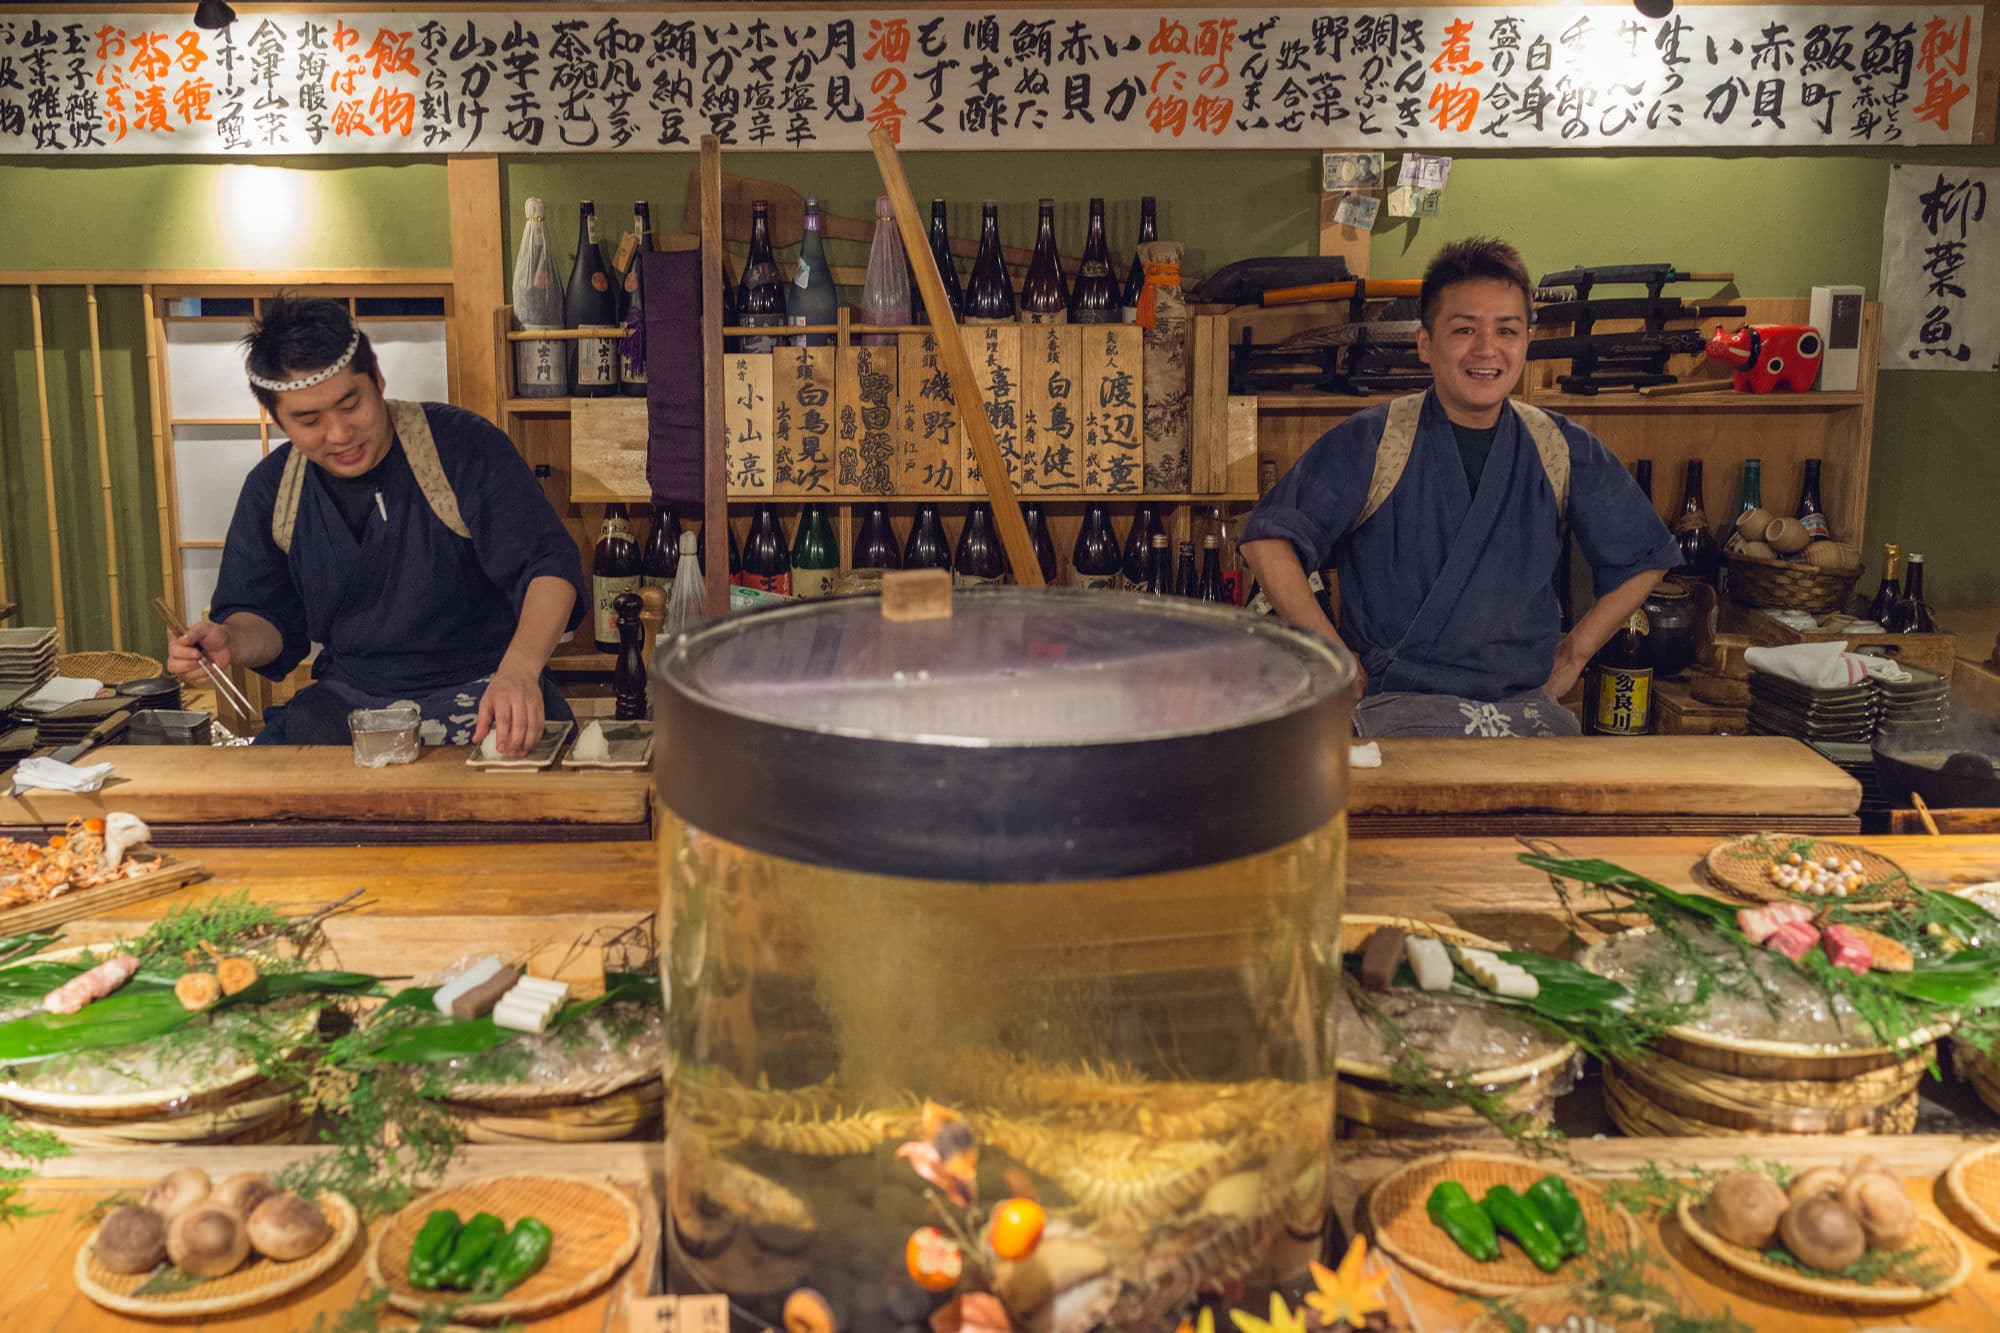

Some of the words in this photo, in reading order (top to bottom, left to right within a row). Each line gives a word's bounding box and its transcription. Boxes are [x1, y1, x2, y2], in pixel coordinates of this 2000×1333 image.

[62, 23, 106, 147] 玉子雑炊
[94, 24, 131, 143] おにぎり
[129, 31, 176, 133] 茶漬
[173, 29, 214, 124] 各種
[331, 19, 375, 137] わっぱ飯
[365, 27, 420, 137] 飯物
[418, 20, 451, 147] おくら刻み
[450, 19, 498, 151] 山かけ
[501, 19, 545, 146] 山芋千切
[549, 19, 599, 146] 茶碗むし
[593, 17, 645, 149] 和風サラダ
[646, 19, 696, 145] 鮪納豆
[700, 22, 742, 145] いか納豆
[777, 24, 818, 149] いか塩辛
[818, 19, 865, 122] 月見
[862, 18, 911, 145] 酒の肴
[913, 16, 960, 134] もずく
[1004, 19, 1056, 129] 鮪ぬた
[1058, 20, 1099, 124] 赤貝
[1103, 34, 1147, 122] いか
[1145, 16, 1191, 137] ぬた物
[1192, 17, 1238, 136] 酢の物
[1235, 16, 1280, 131] ぜんまい
[1272, 38, 1311, 133] 炊合せ
[1307, 16, 1349, 126] 野菜
[1350, 14, 1399, 135] 鯛かぶと
[1394, 18, 1426, 138] きんき
[1428, 17, 1484, 132] 煮物
[1480, 16, 1525, 138] 盛り合せ
[1512, 34, 1555, 131] 白身
[1646, 14, 1694, 129] 生うに
[1703, 35, 1750, 125] いか
[1751, 20, 1795, 129] 赤貝
[1882, 82, 1909, 142] 中とろ
[1912, 15, 1971, 132] 刺身
[1909, 173, 1988, 362] 柳葉魚
[736, 383, 766, 489] 小山亮
[1039, 370, 1081, 490] 白鳥健一
[1100, 371, 1142, 493] 渡辺薫
[1612, 673, 1636, 732] 多良川
